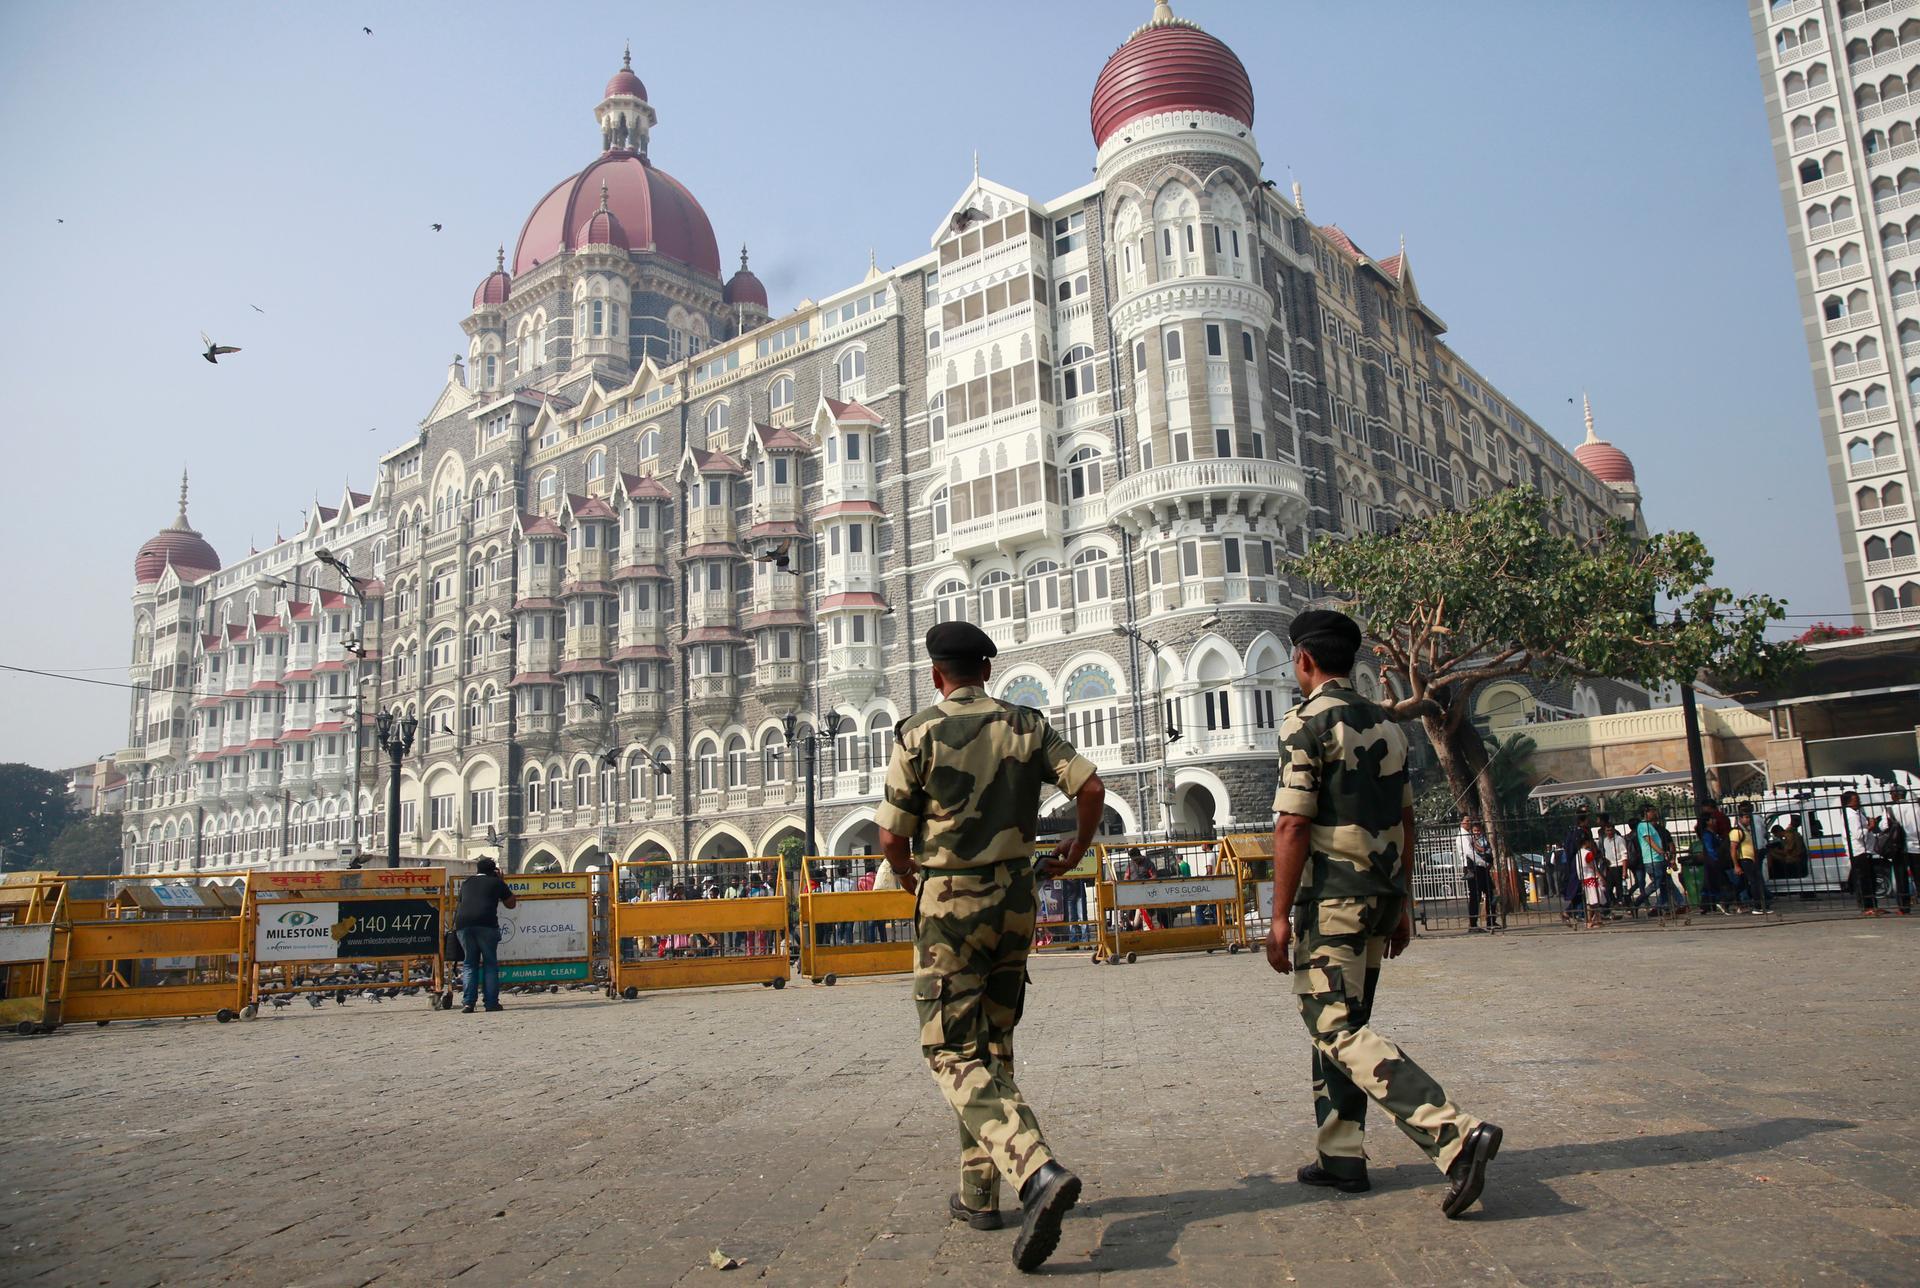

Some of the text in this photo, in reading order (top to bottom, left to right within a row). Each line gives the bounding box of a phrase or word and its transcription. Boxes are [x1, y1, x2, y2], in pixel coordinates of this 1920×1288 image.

[507, 881, 576, 892] MBAI POLICE
[1181, 885, 1211, 894] GLOBAL
[171, 888, 193, 899] LIC
[391, 914, 432, 932] 4477
[266, 927, 329, 939] MILESTONE
[512, 969, 546, 978] MUMBAI
[550, 967, 577, 976] CLEAN
